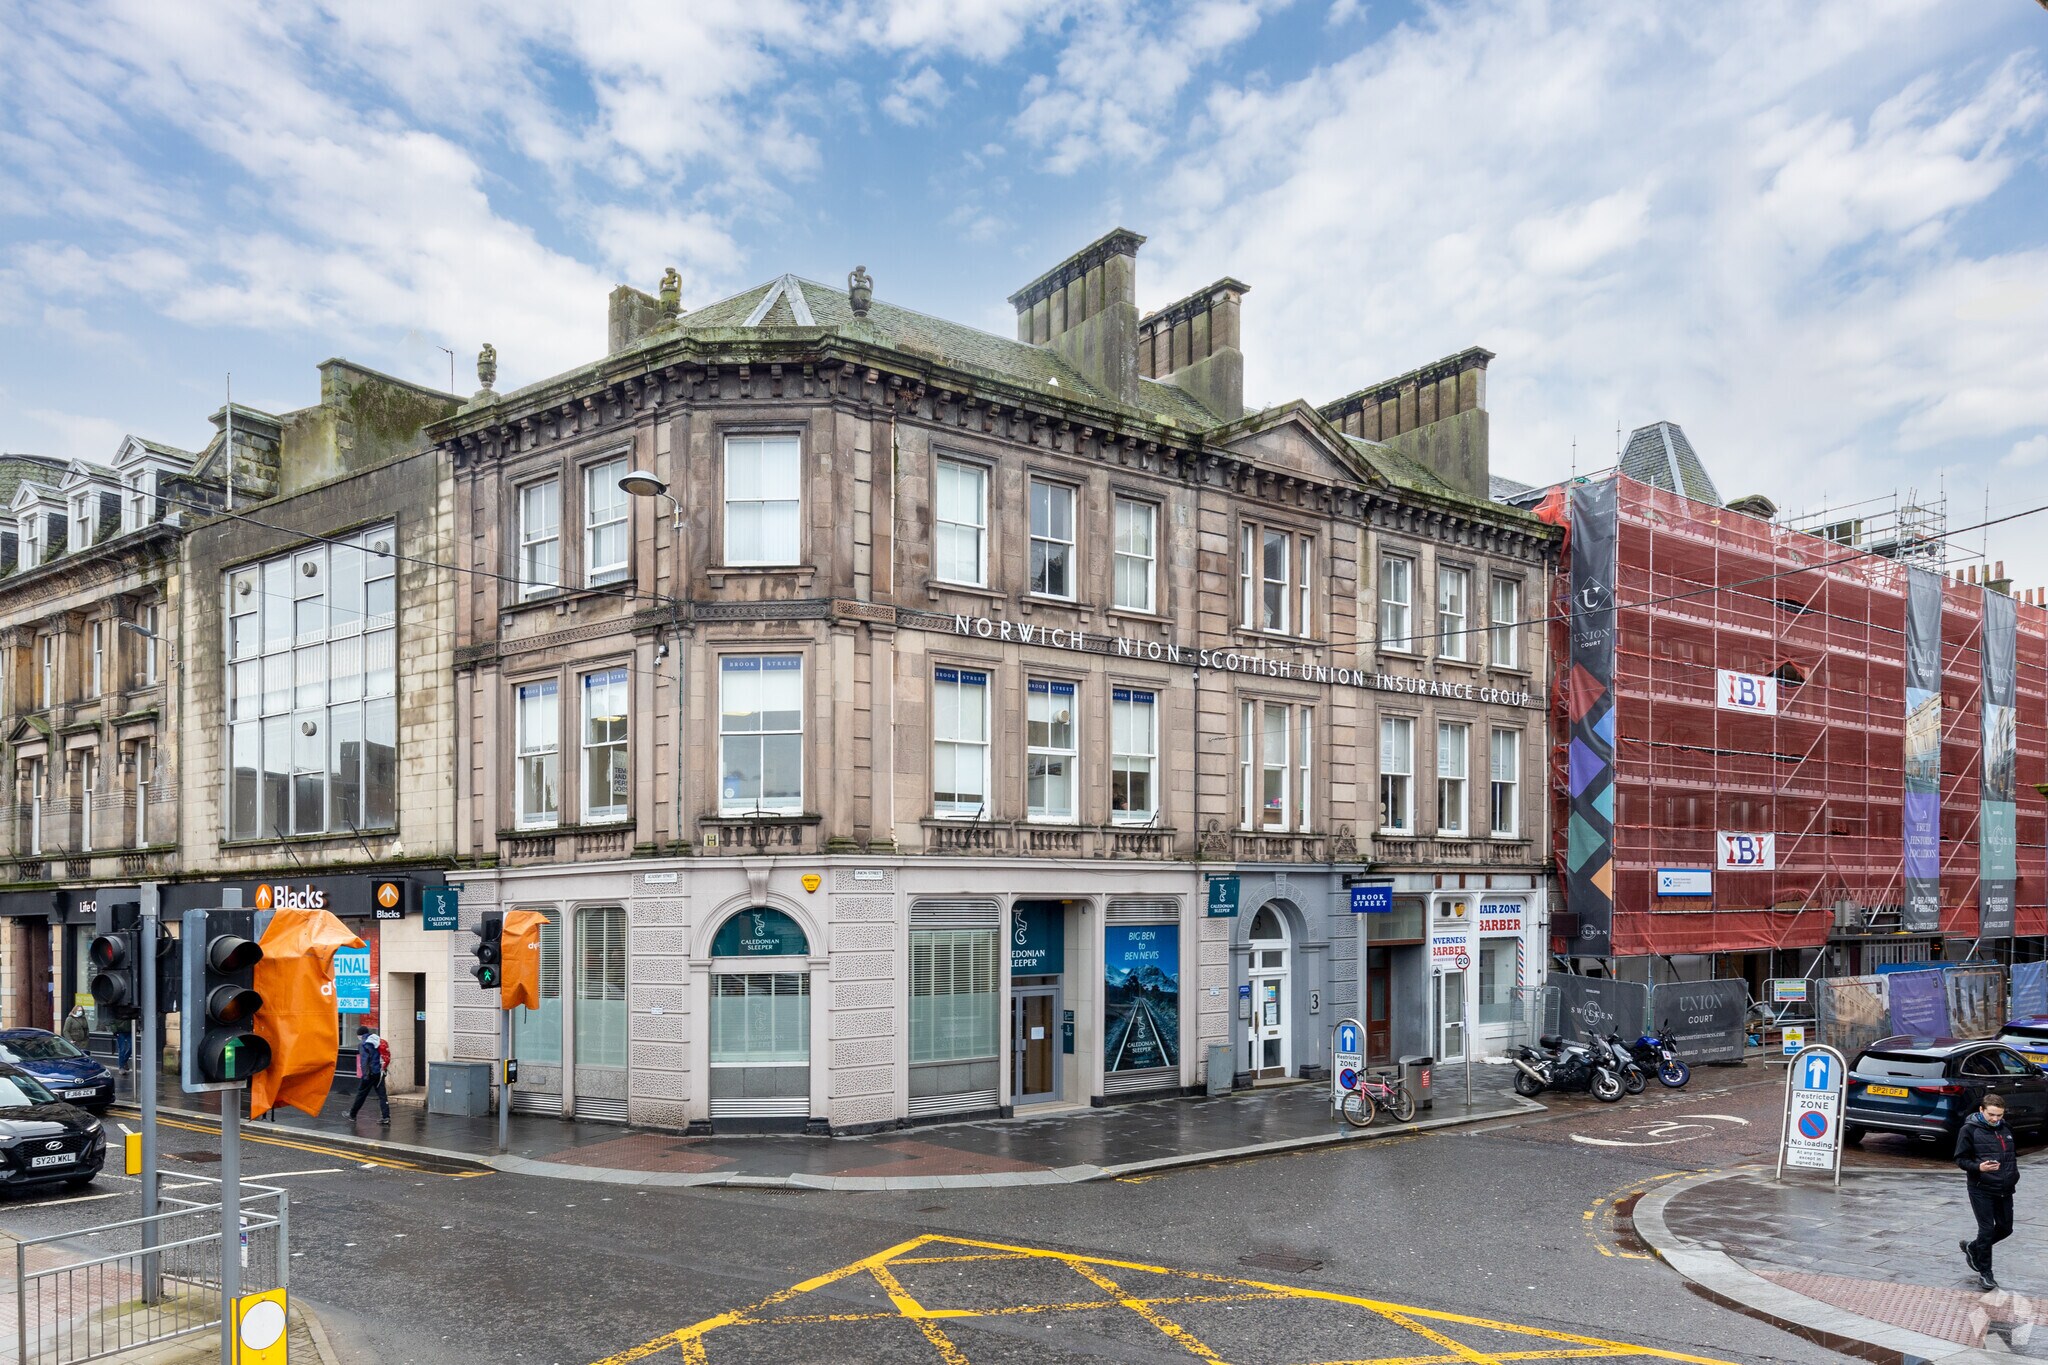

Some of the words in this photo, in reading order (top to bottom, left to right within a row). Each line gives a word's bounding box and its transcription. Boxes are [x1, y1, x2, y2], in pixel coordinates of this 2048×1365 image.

[1574, 628, 1610, 642] UNION
[1581, 640, 1601, 648] COURT
[955, 614, 1083, 650] NORWICH
[1118, 637, 1179, 663] NION
[1199, 649, 1291, 678] SCOTTISH
[1302, 664, 1363, 687] UNION
[1377, 673, 1474, 700] INSURANCE
[1480, 687, 1529, 707] GROUP
[1728, 675, 1766, 707] IBI
[1727, 836, 1764, 864] IBI
[274, 884, 324, 909] Blacks
[80, 901, 90, 912] Life
[1499, 904, 1521, 913] ZONE
[376, 910, 400, 919] Blacks
[1480, 919, 1521, 931] BARBER
[1128, 931, 1140, 941] BIG
[1141, 931, 1156, 940] BEN
[1138, 942, 1146, 950] to
[1011, 949, 1045, 958] EDONIAN
[1124, 951, 1139, 961] BEN
[1140, 950, 1159, 960] NEVIS
[334, 957, 369, 973] FINAL
[1312, 994, 1319, 1009] 3
[1680, 994, 1723, 1011] UNION
[1688, 1014, 1713, 1024] COURT
[1796, 1092, 1835, 1101] Restricted
[1800, 1101, 1829, 1109] ZONE
[1804, 1139, 1833, 1149] loading
[36, 1156, 56, 1165] SY20
